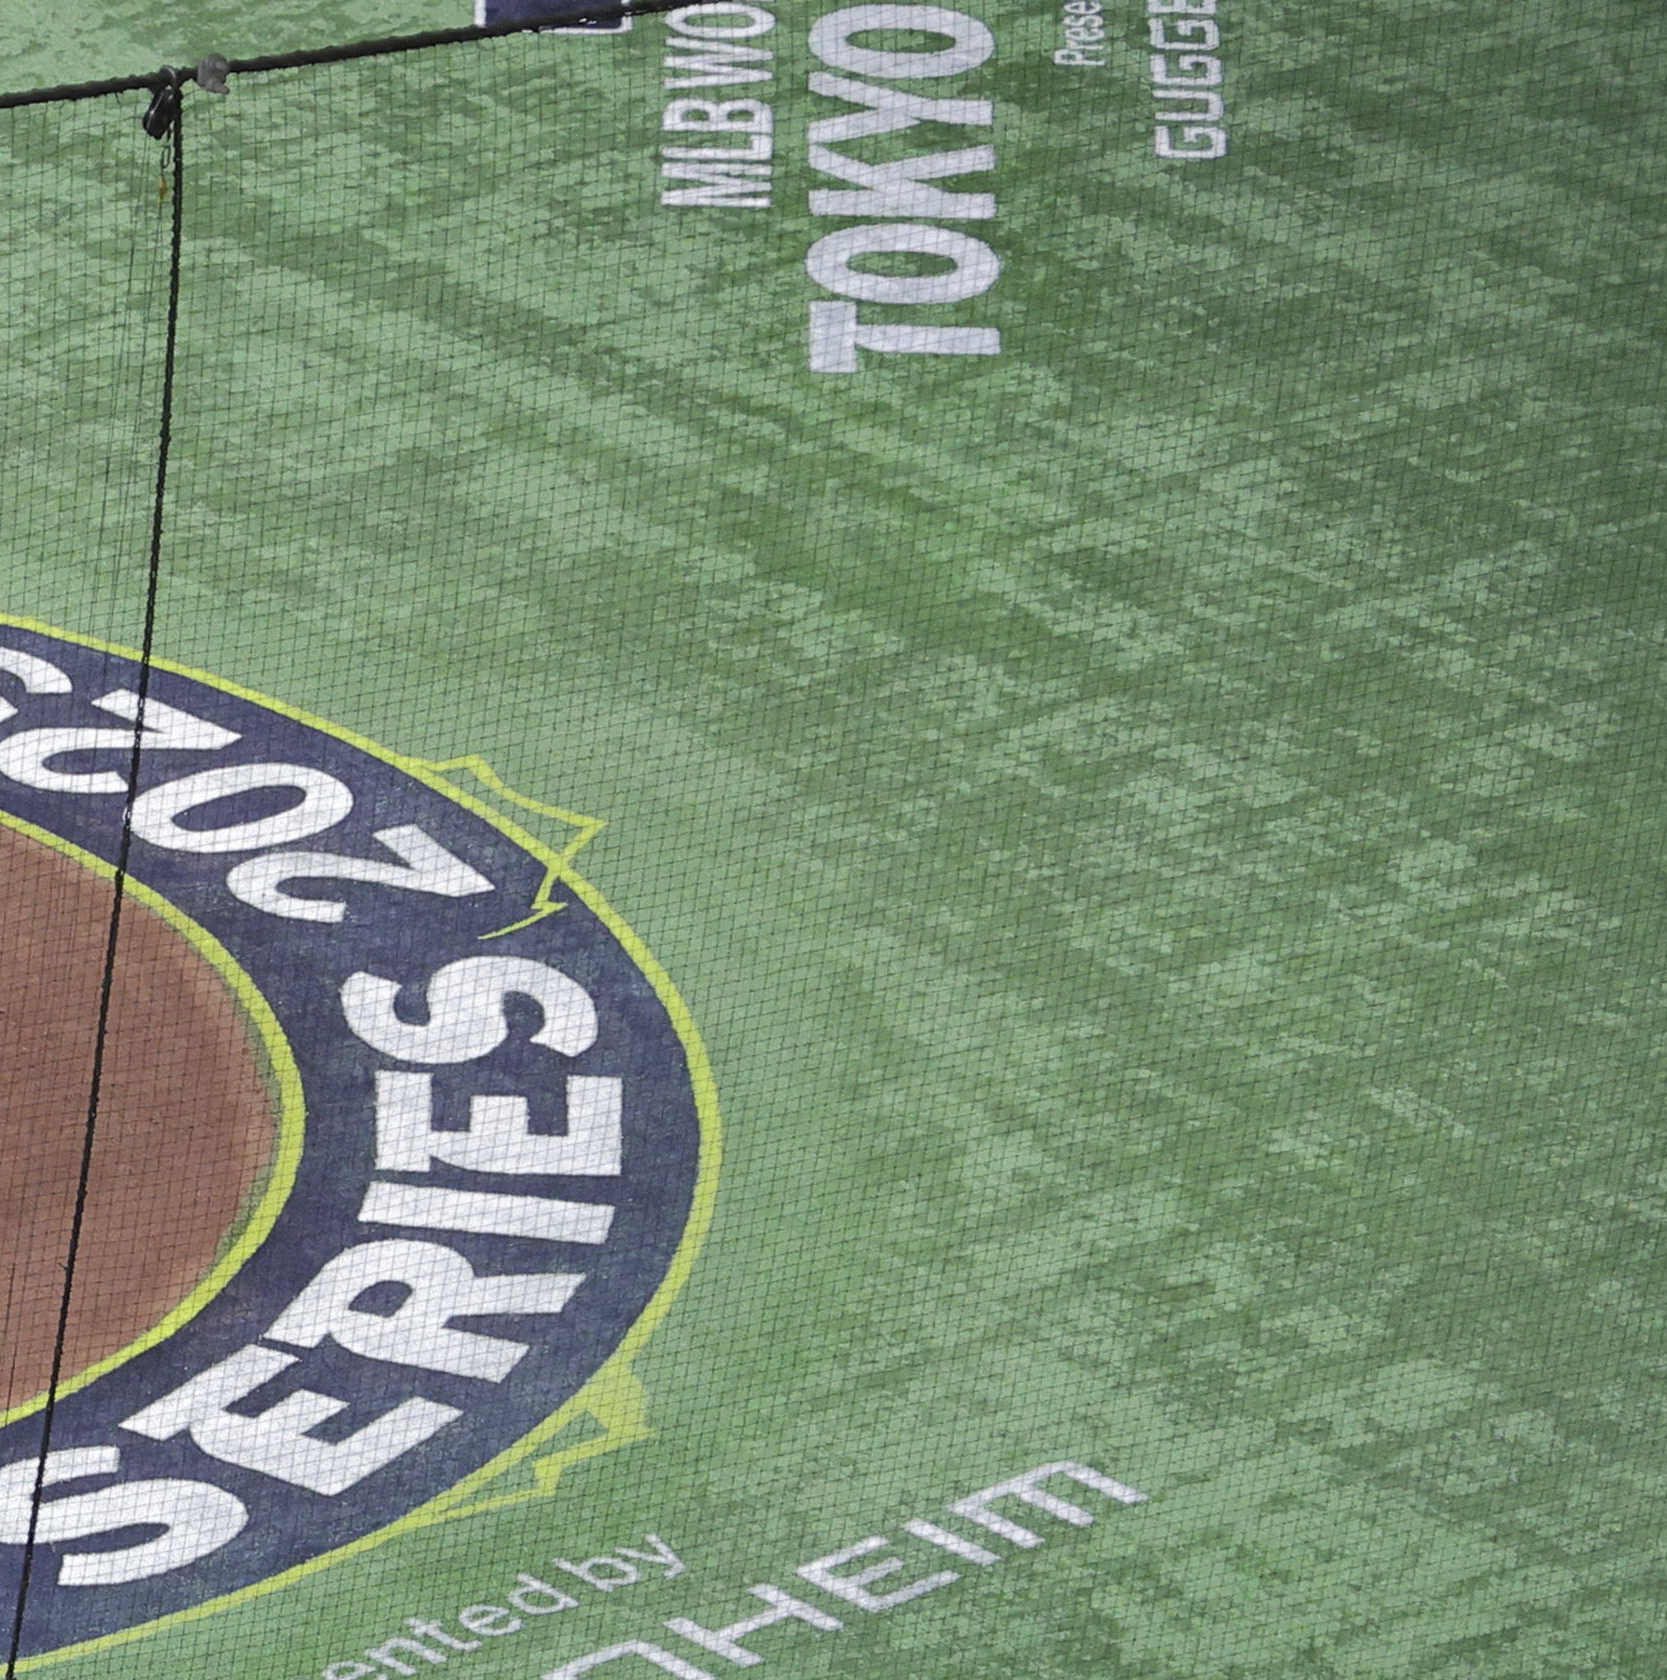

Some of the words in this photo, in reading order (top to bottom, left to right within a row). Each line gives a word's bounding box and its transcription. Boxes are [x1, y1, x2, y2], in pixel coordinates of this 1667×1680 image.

[661, 98, 775, 208] MLB
[805, 4, 1002, 373] TOKYO
[552, 1533, 687, 1593] by
